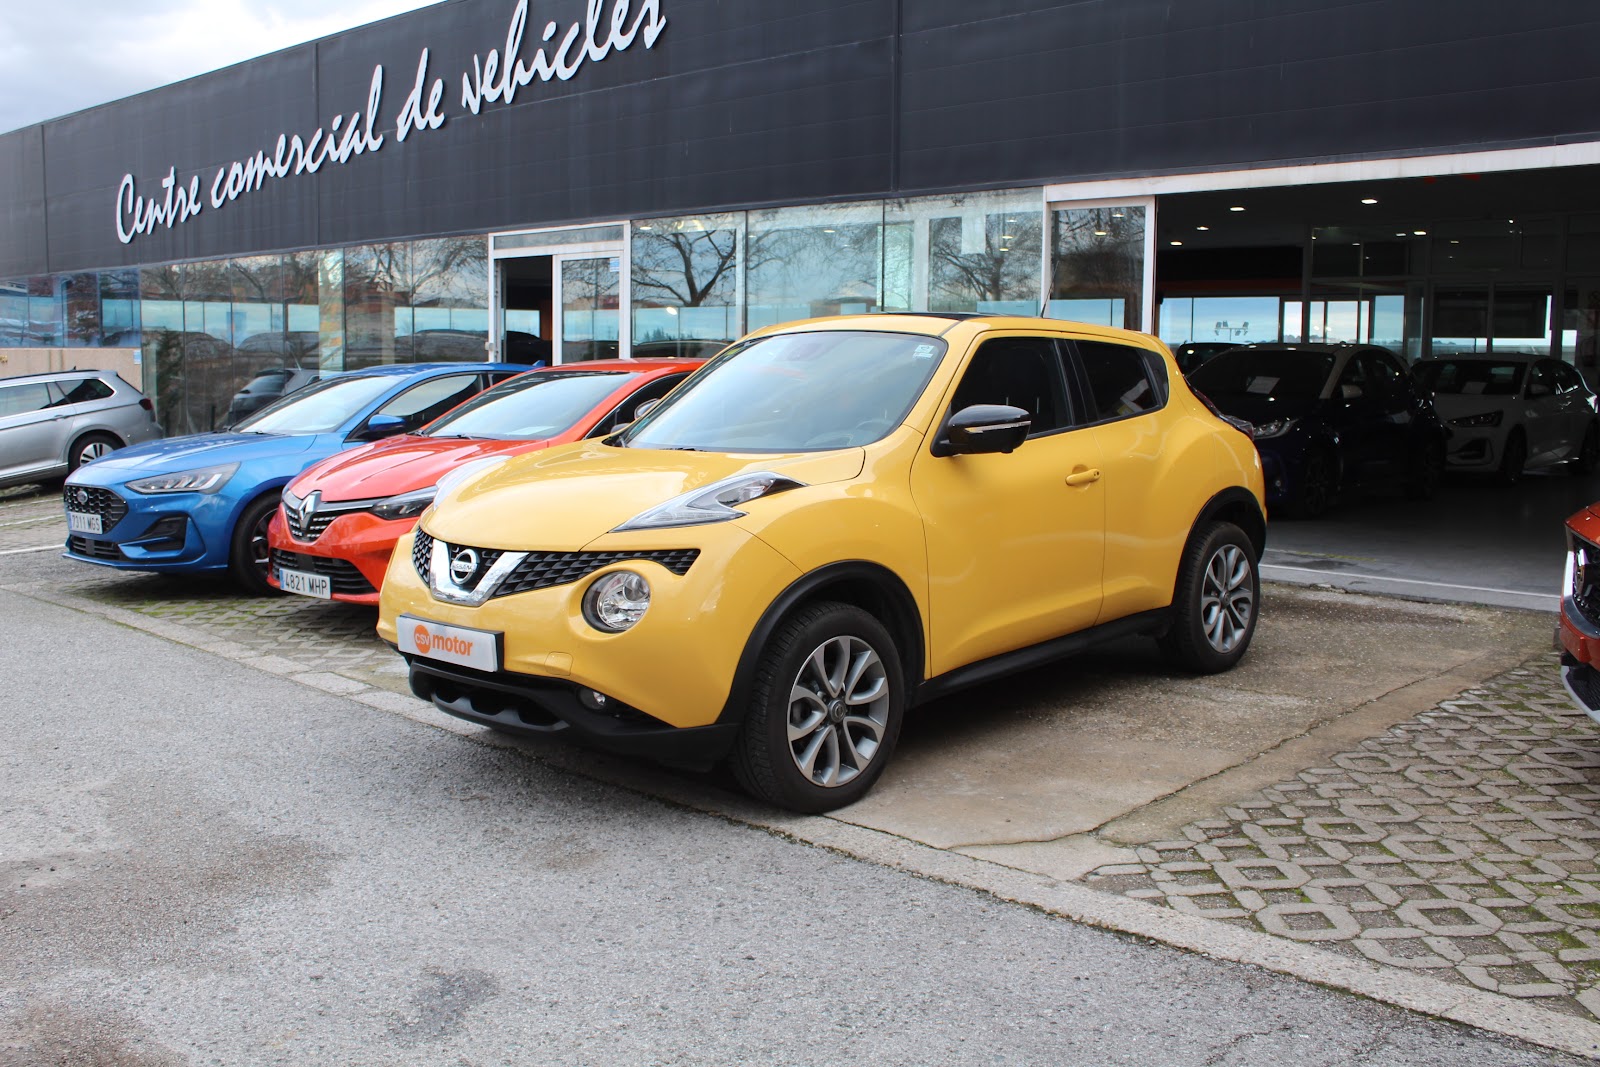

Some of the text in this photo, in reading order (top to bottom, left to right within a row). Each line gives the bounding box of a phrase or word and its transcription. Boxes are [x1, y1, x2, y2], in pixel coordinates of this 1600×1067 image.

[117, 0, 667, 244] Centre comercial de vehicles
[72, 514, 86, 530] 7311
[285, 573, 327, 596] 4821 MHP
[432, 634, 473, 656] motor
